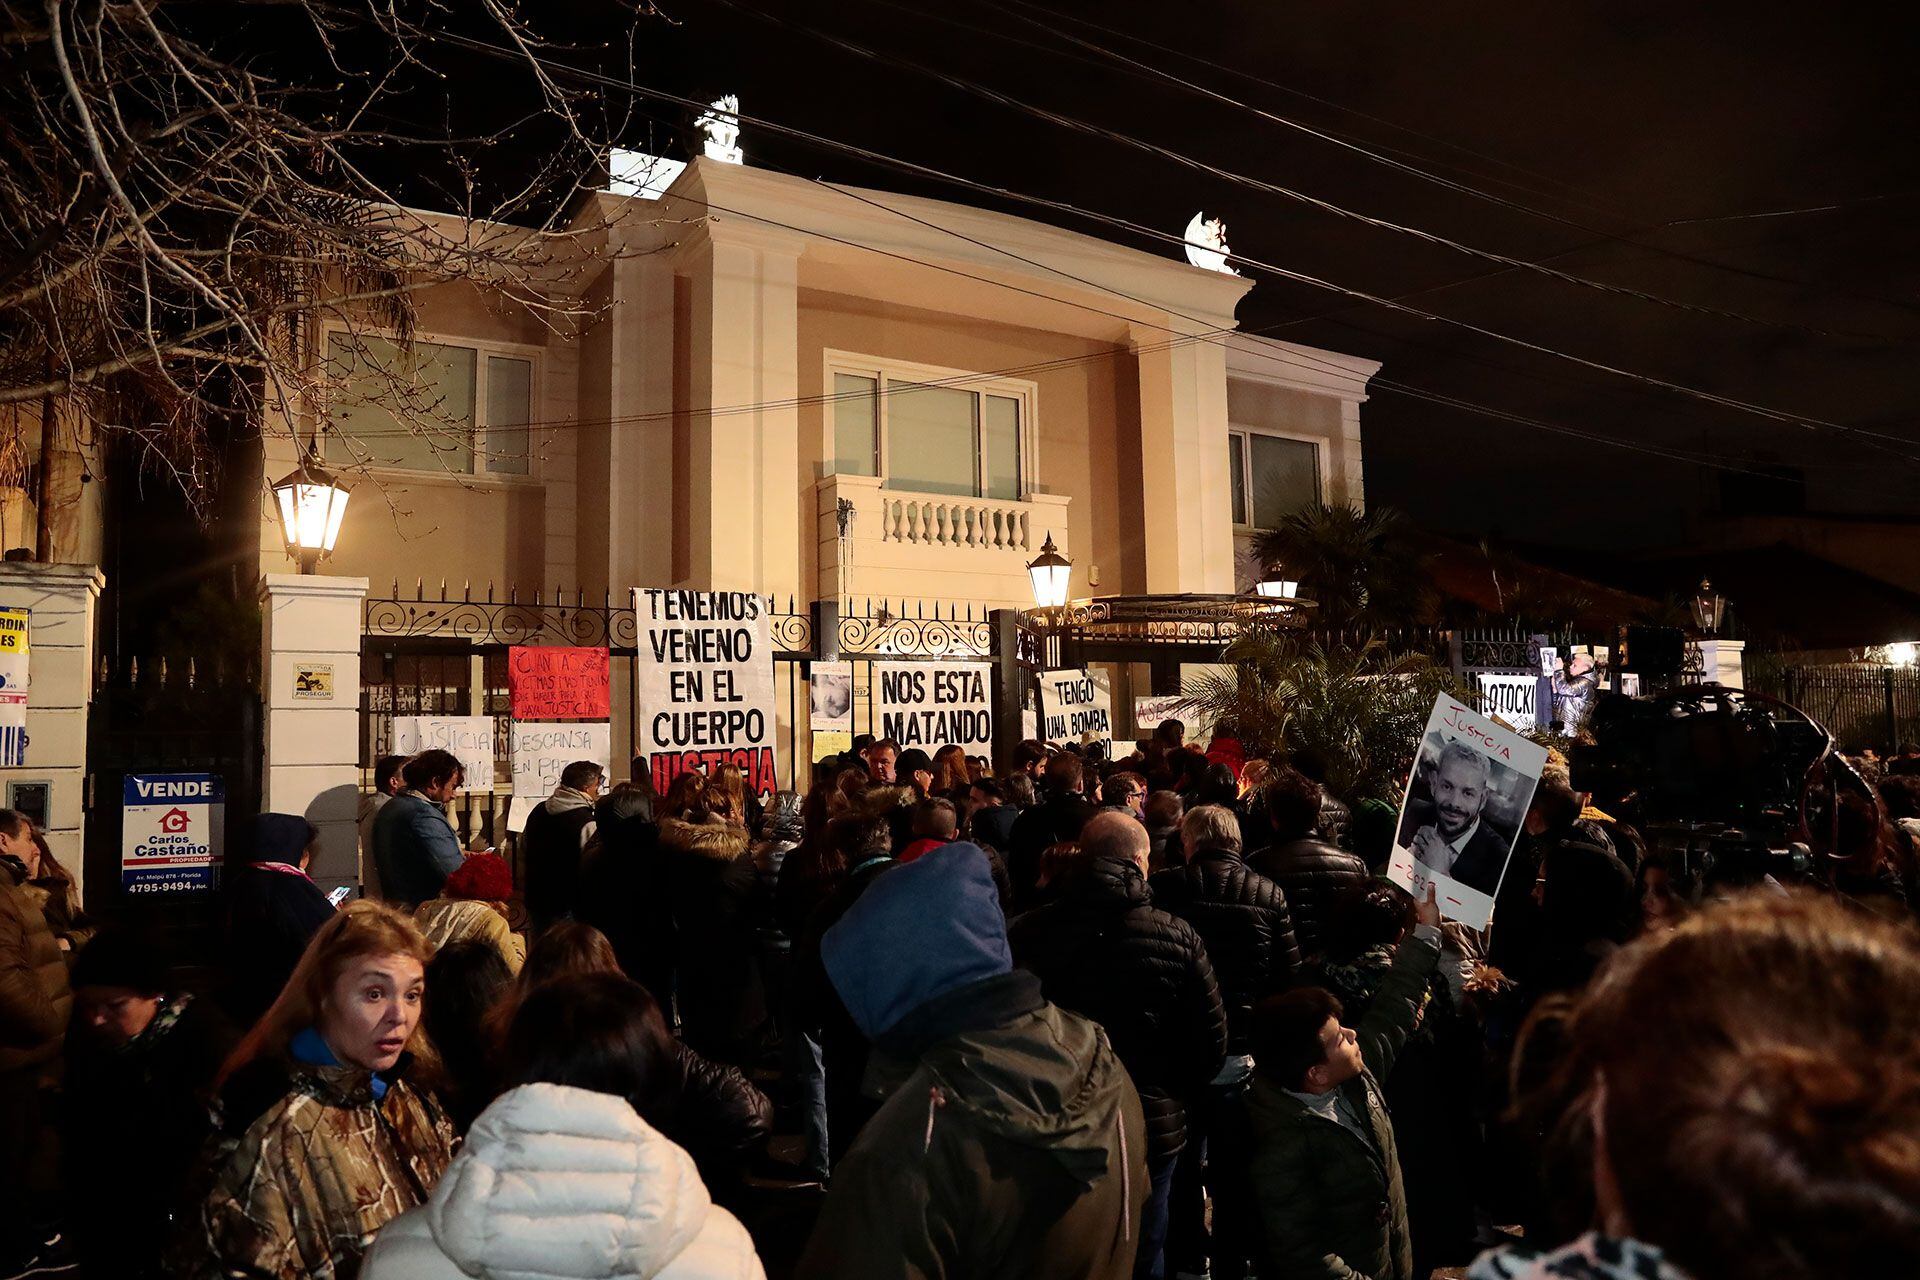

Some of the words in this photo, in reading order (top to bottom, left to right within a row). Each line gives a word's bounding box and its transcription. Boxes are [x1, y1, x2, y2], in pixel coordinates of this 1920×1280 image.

[644, 589, 758, 621] TENEMOS
[650, 628, 752, 663] VENENO
[671, 670, 704, 703] EN
[713, 670, 743, 702] EL
[882, 670, 926, 704] NOS
[934, 670, 986, 704] ESTA
[1055, 678, 1095, 706] TENGO
[1483, 683, 1535, 715] LOTOCKI
[401, 718, 490, 754] JUSTICIA
[652, 708, 765, 748] CUERPO
[883, 709, 991, 746] MATANDO
[1047, 715, 1068, 740] UNA
[1071, 708, 1110, 737] BOMBA
[1444, 705, 1510, 761] JUSTICIA
[512, 730, 592, 754] DESCANSA
[512, 759, 531, 774] EN
[136, 781, 214, 798] VENDE
[134, 843, 208, 857] Castaño
[148, 835, 190, 844] Carlos
